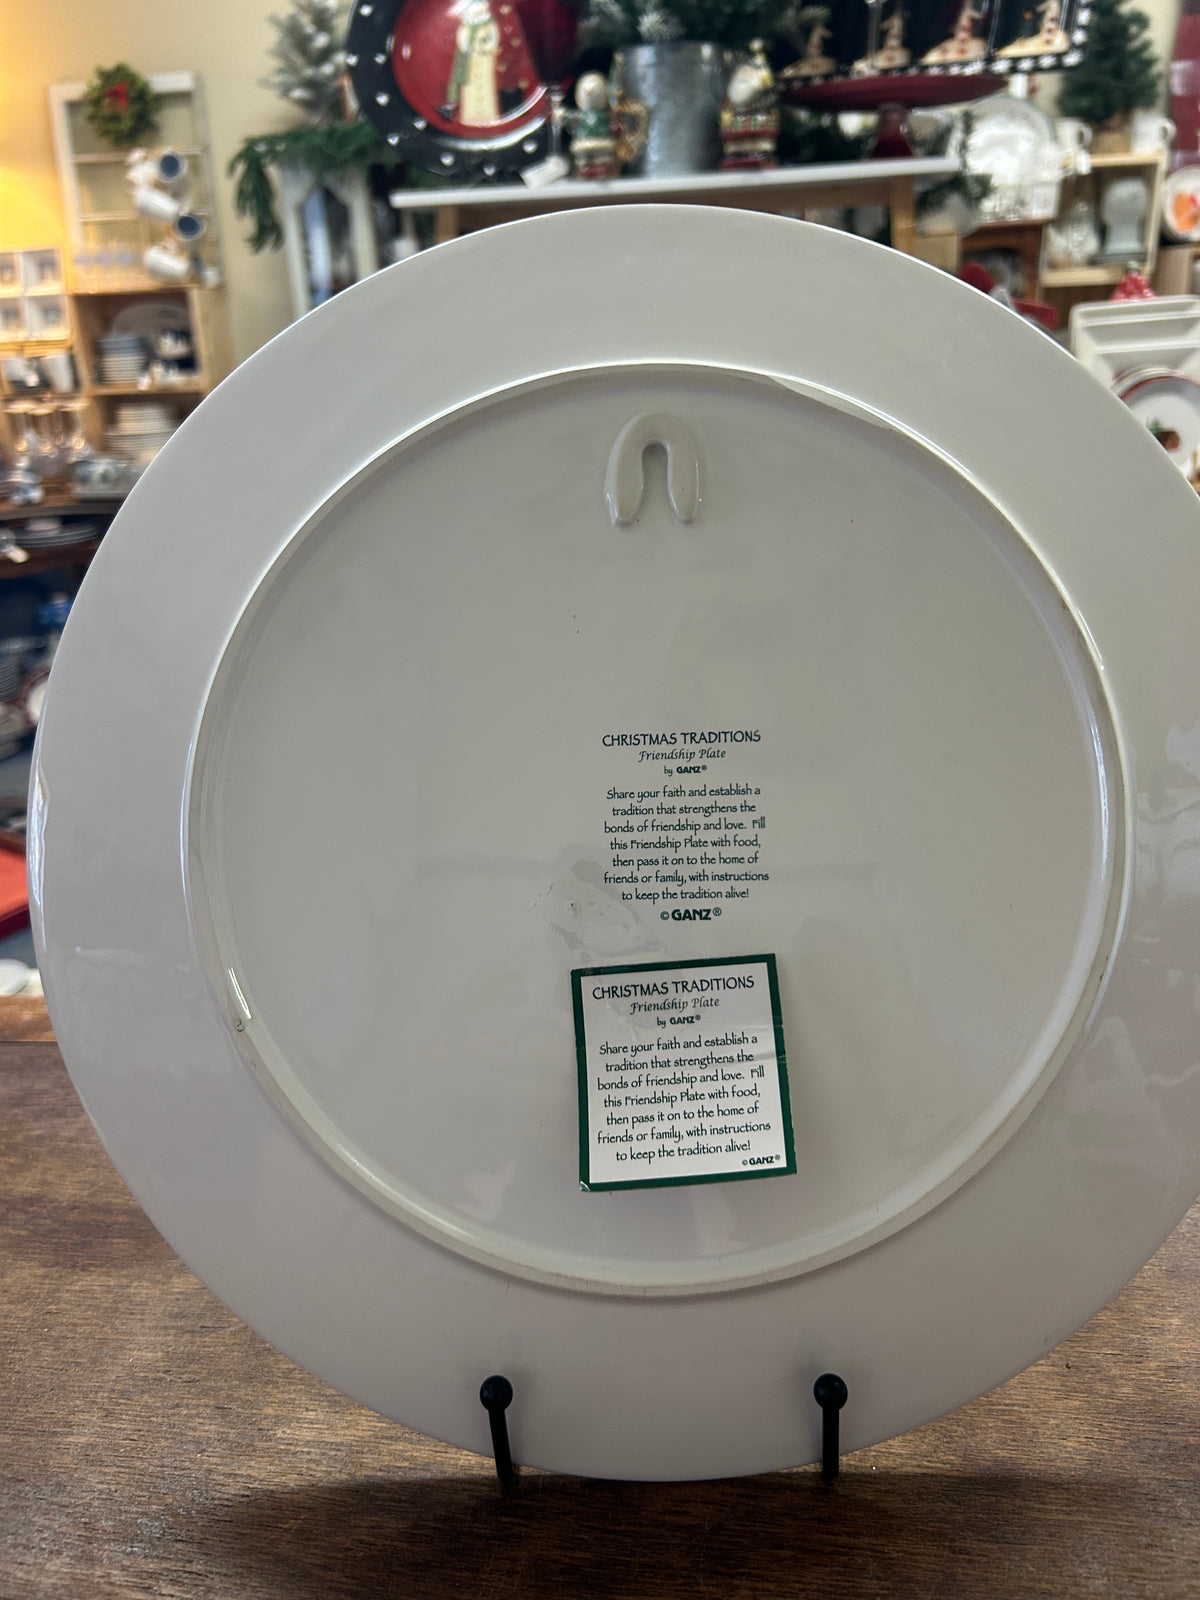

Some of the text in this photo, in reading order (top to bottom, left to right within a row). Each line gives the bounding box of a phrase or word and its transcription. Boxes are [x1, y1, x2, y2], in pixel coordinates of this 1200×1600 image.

[602, 730, 761, 746] CHRISTMAS TRADITIONS
[637, 748, 727, 763] Friendship Plate
[664, 766, 673, 776] by
[606, 783, 761, 802] Share your faith and establish a
[612, 800, 757, 817] tradition that strengthens the
[604, 817, 766, 836] bonds of friendship and love. Fill
[610, 834, 761, 853] this Friendship Plate with food,
[612, 851, 759, 871] then pass it on to the home of
[604, 870, 770, 886] friends or family, with instructions
[622, 886, 749, 904] to keep the tradition alive!
[592, 975, 755, 999] CHRISTMAS TRADITIONS
[629, 997, 720, 1015] Friendship Plate
[657, 1017, 666, 1028] by
[599, 1031, 758, 1056] Share your faith and establish a
[605, 1050, 754, 1072] tradition that strengthens the
[597, 1065, 765, 1090] bonds of friendship and love. Fill
[603, 1084, 761, 1108] this Friendship Plate with food,
[606, 1101, 760, 1128] then pass it on to the home of
[597, 1122, 771, 1144] friends or family, with instructions
[616, 1139, 751, 1165] to keep the tradition alive!
